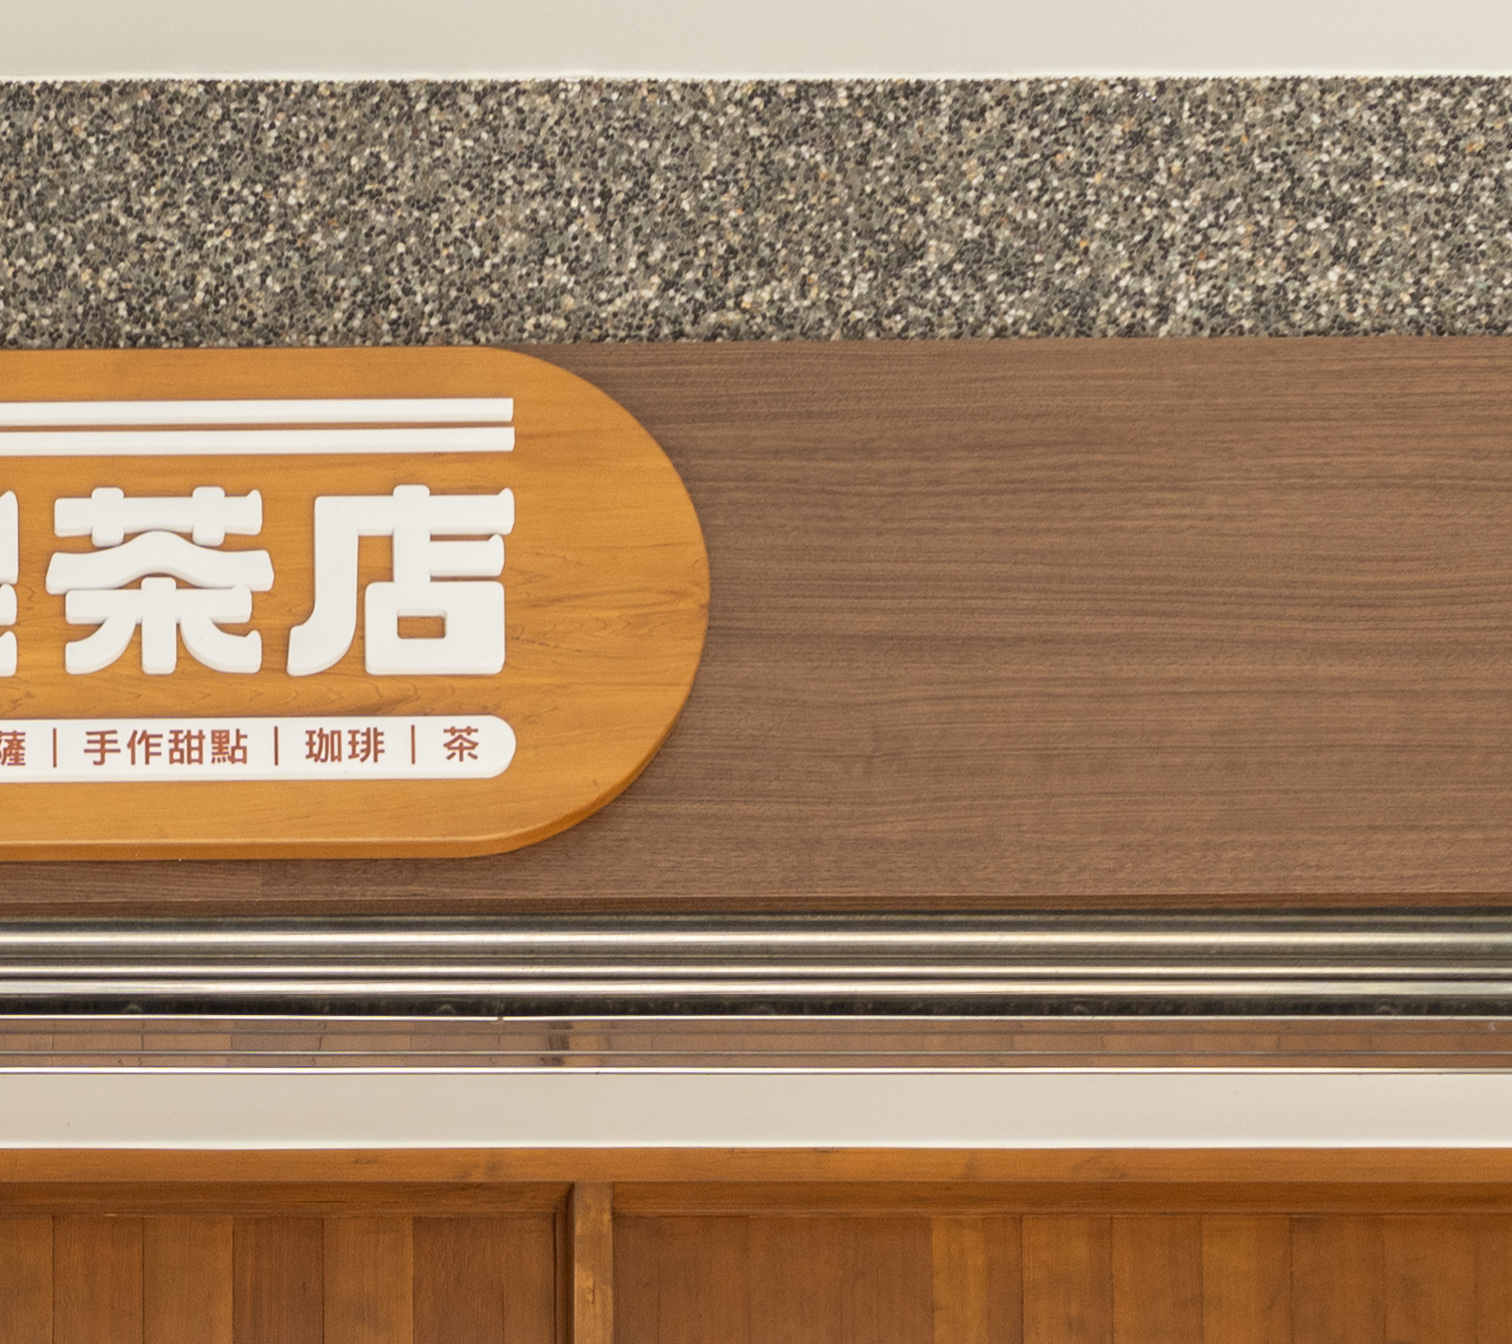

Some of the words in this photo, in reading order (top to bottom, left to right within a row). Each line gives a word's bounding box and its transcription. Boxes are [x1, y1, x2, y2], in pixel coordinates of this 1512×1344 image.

[83, 727, 249, 767] 手作甜點
[304, 726, 386, 764] 珈琲
[442, 725, 480, 763] 茶
